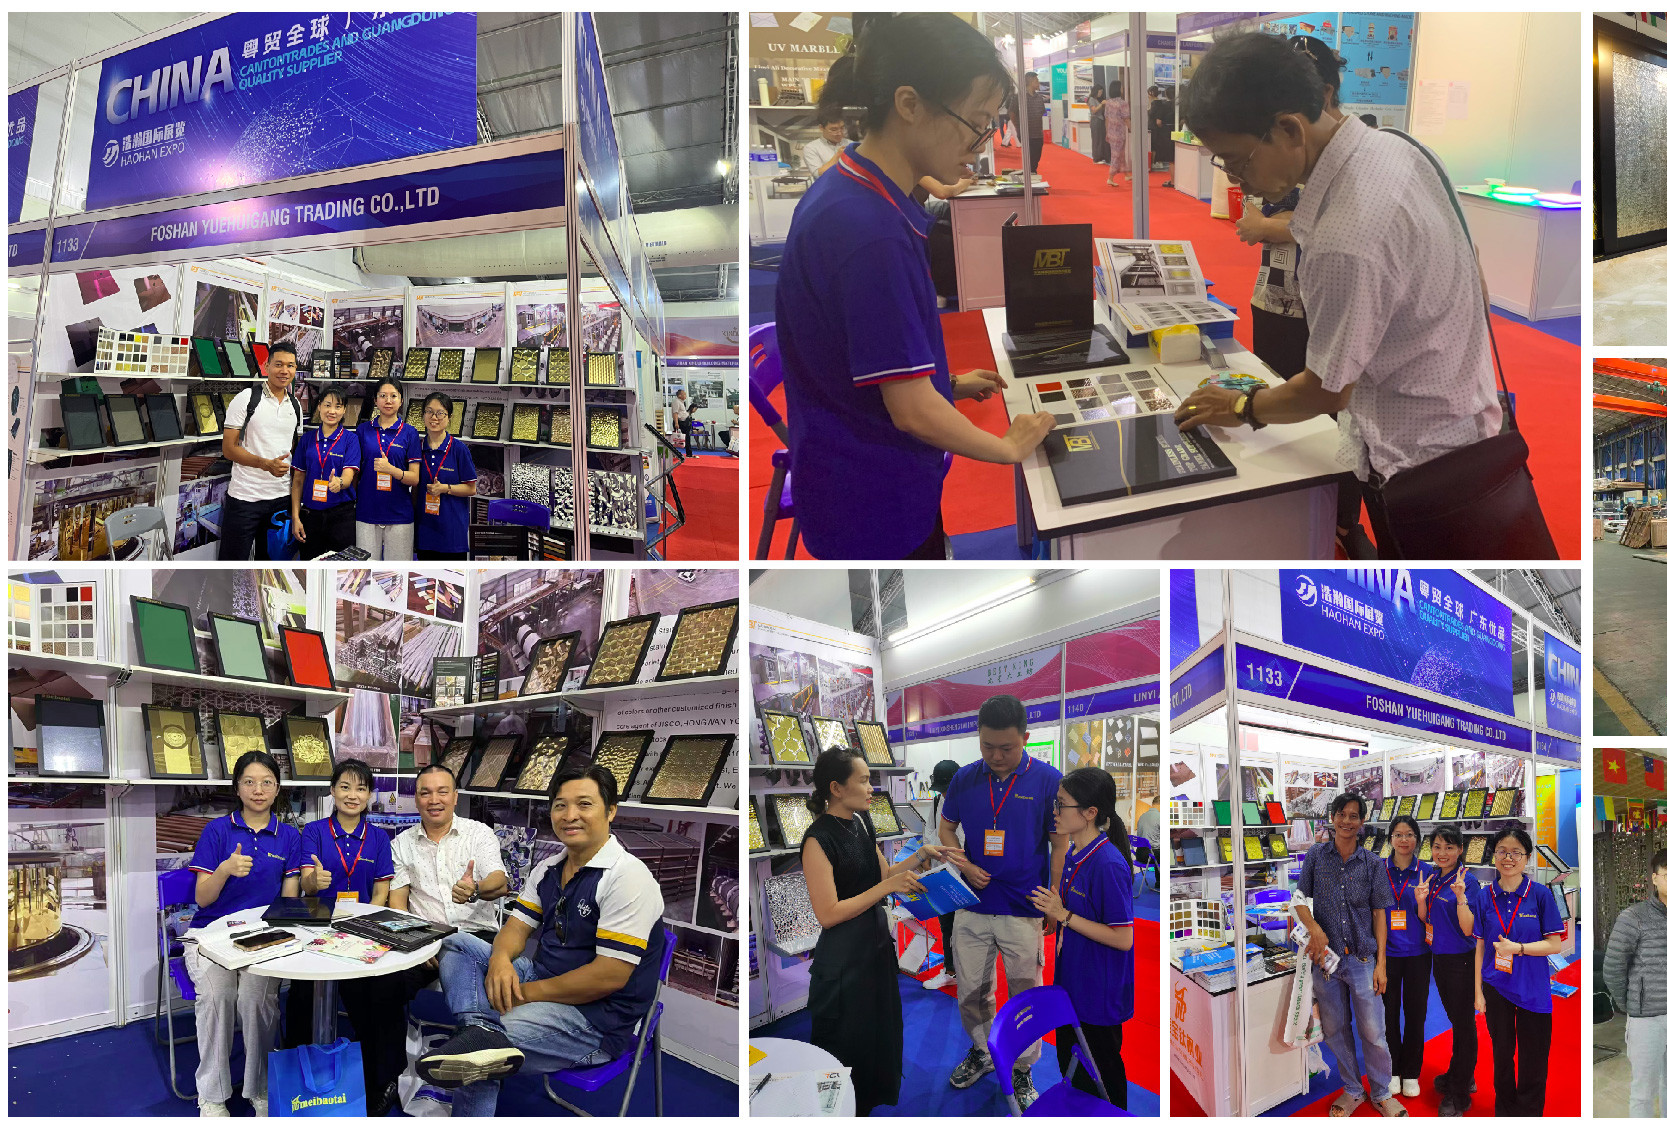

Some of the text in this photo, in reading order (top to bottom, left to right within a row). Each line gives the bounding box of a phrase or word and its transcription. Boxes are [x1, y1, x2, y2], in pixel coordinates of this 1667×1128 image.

[240, 39, 330, 77] CANTONTRADES
[332, 31, 359, 51] AND
[768, 43, 786, 52] UV
[106, 47, 235, 125] CHINA
[239, 51, 343, 91] QUALITY SUPPLIER
[121, 142, 185, 167] HAOHAN EXPO
[150, 186, 440, 242] FOSHAN YUEHUIGANG TRADING CO.,LTD
[57, 238, 79, 254] 1133
[1033, 248, 1071, 268] MBT
[1332, 569, 1416, 614] HINA
[1321, 604, 1385, 640] HAOHAN EXPO
[1246, 662, 1283, 687] 1133
[1548, 653, 1581, 690] CHIN
[715, 701, 737, 710] finish
[1067, 704, 1084, 714] 1140
[1133, 692, 1156, 702] LINYI
[1366, 695, 1404, 717] FOSHAN
[1406, 705, 1455, 729] YUEHUIGANG
[1456, 718, 1484, 736] TRADING
